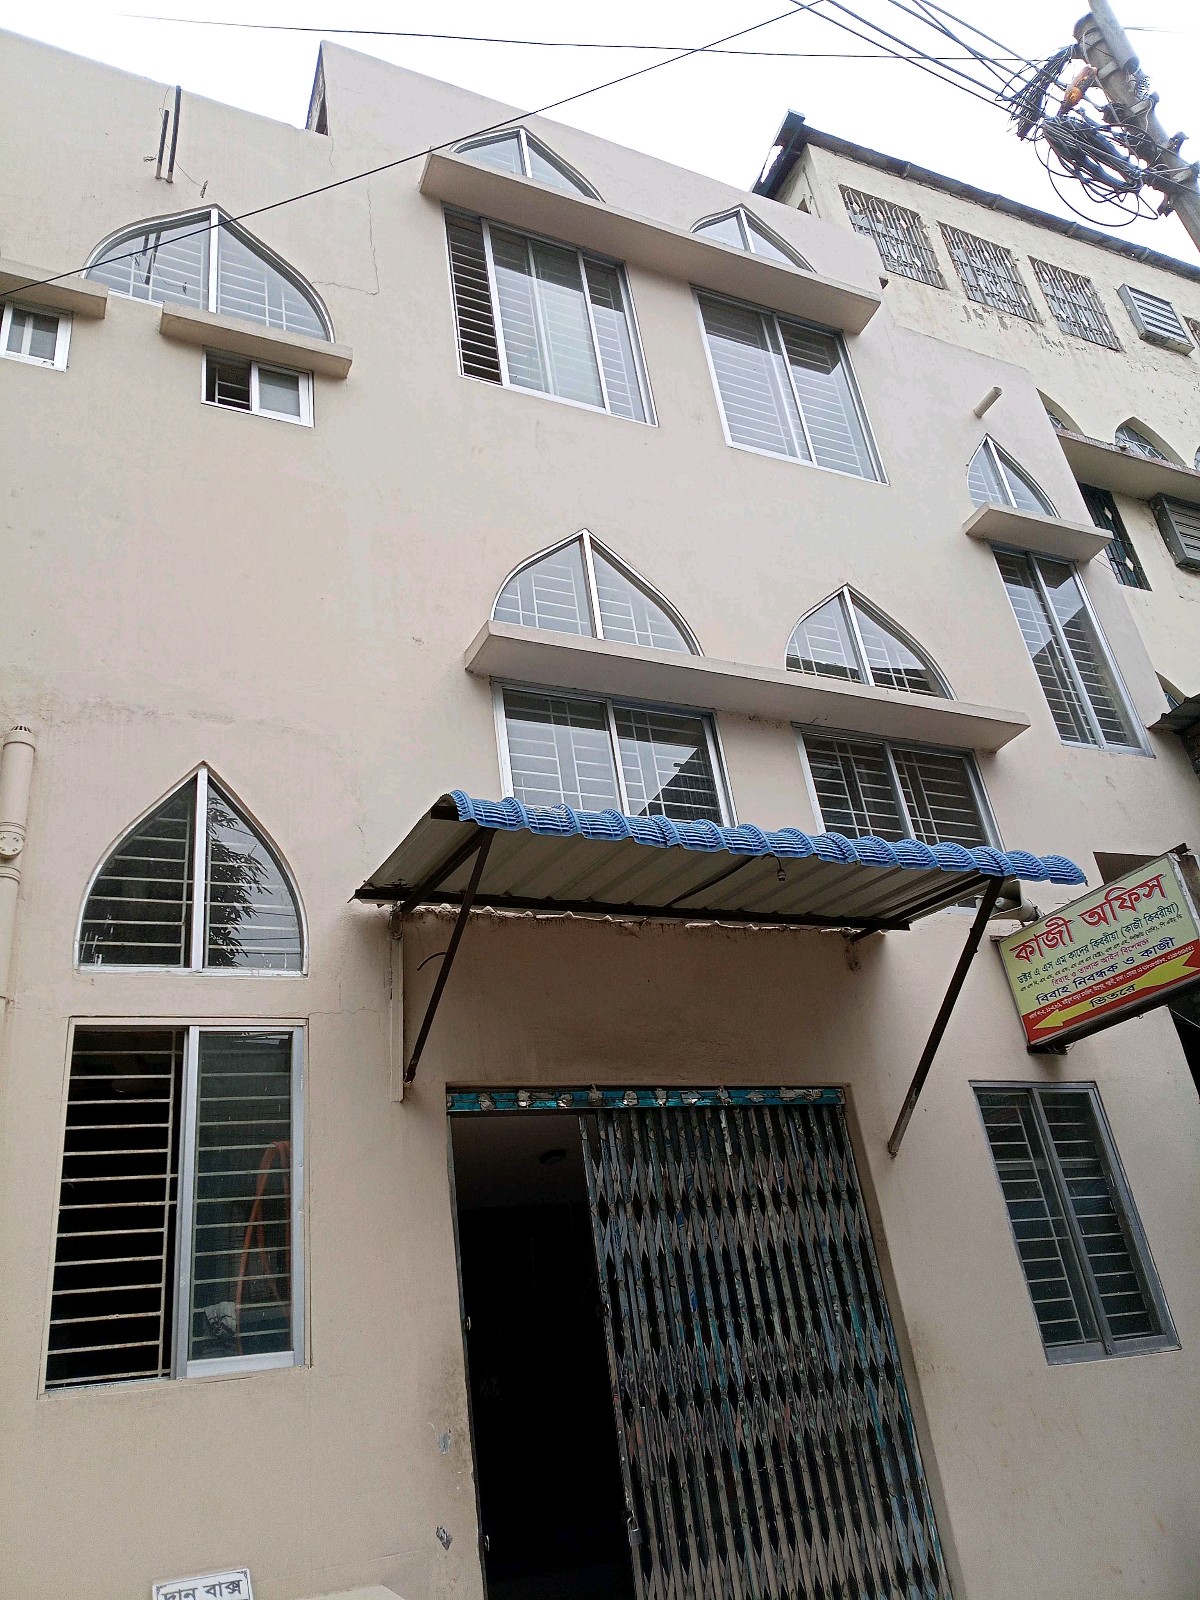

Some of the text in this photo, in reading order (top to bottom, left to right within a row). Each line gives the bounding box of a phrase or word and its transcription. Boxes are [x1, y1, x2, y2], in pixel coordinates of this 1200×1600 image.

[1009, 916, 1074, 963] কাজী
[1078, 874, 1166, 927] অফিস
[1035, 936, 1174, 1005] বিবাহ নিবন্ধক ও কাজী
[1088, 983, 1135, 1007] ভিতরে
[203, 1579, 243, 1597] বাক্স
